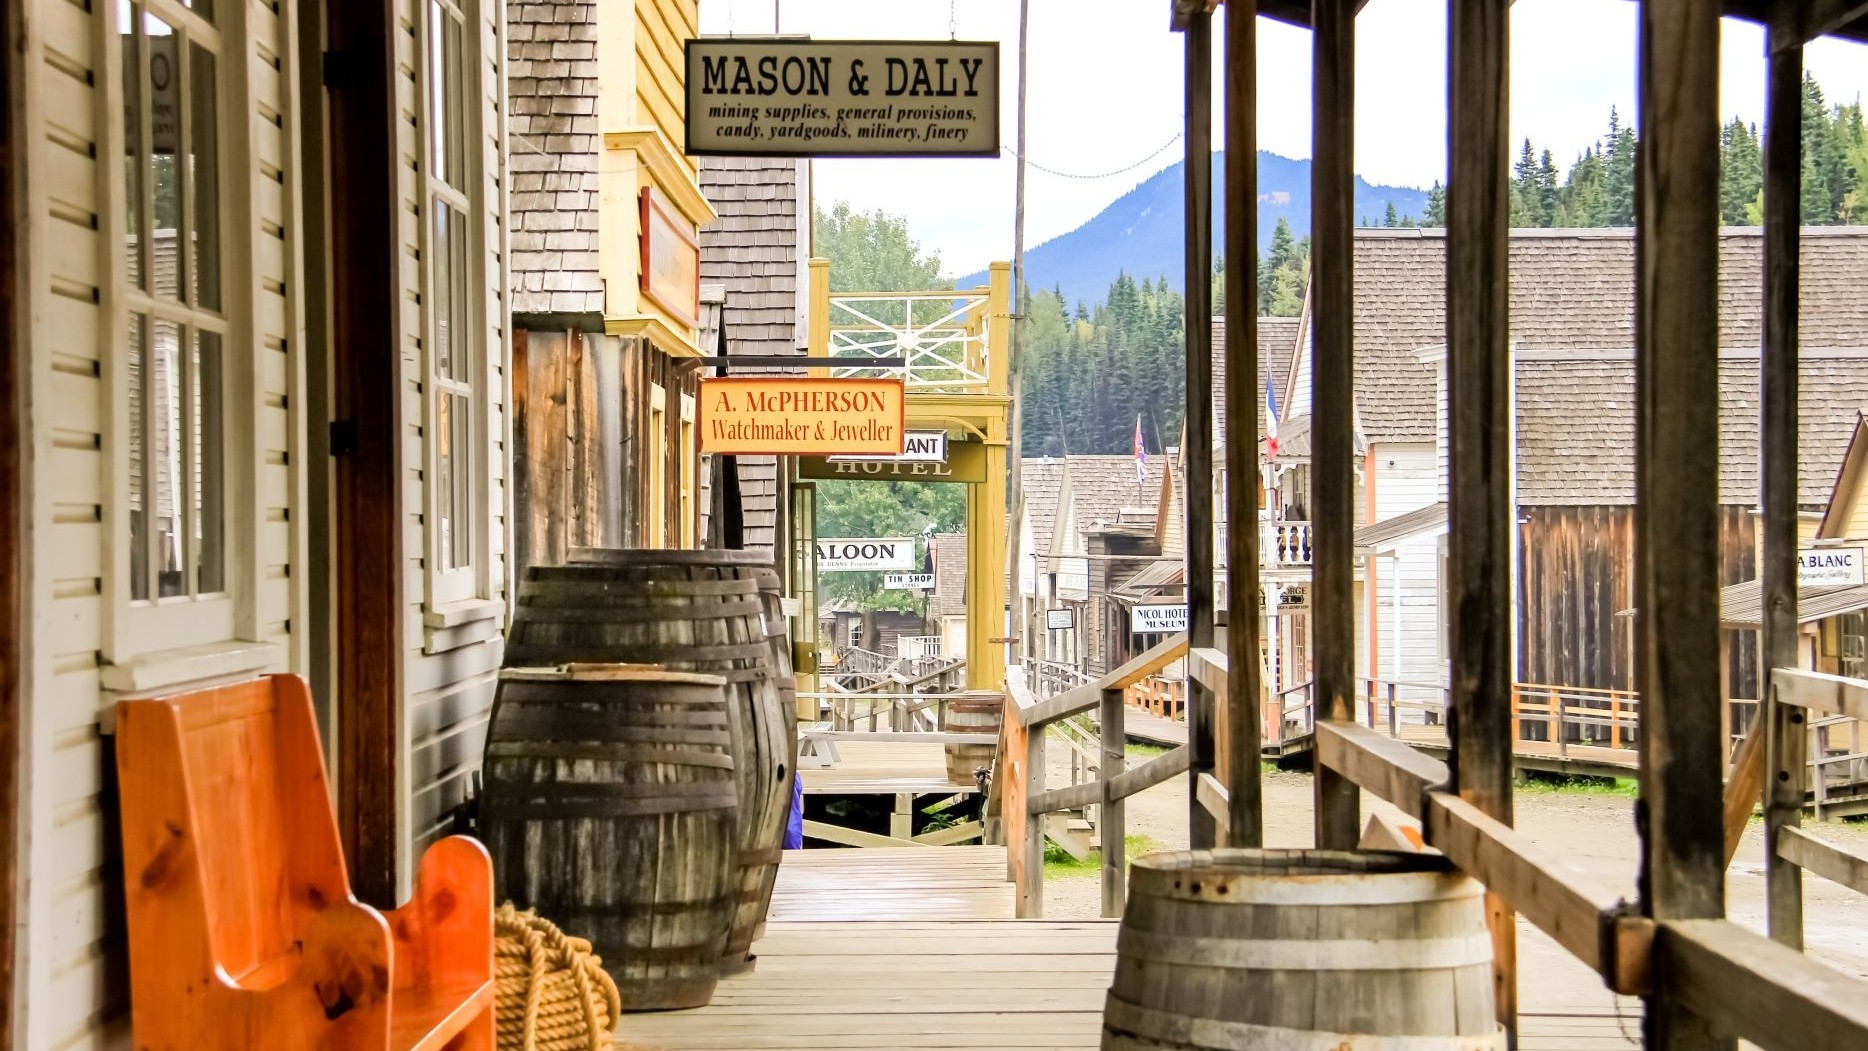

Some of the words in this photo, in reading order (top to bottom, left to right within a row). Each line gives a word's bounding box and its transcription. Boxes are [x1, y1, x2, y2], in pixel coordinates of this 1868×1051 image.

[702, 55, 832, 96] MASON
[848, 58, 869, 96] &
[885, 57, 983, 97] DALY
[708, 103, 760, 121] mining
[764, 104, 831, 122] supplies,
[836, 104, 893, 122] general
[896, 104, 977, 123] provisions,
[716, 122, 764, 140] candy,
[767, 122, 852, 141] yardgoods,
[857, 123, 921, 142] milinery,
[922, 123, 969, 142] finery
[715, 391, 737, 412] A.
[745, 391, 886, 413] McPHERSON
[711, 418, 810, 441] Watchmaker
[814, 420, 826, 441] &
[830, 418, 893, 442] Jeweller
[904, 438, 938, 454] ANT
[817, 544, 895, 560] ALOON
[888, 575, 903, 583] TIN
[908, 574, 932, 583] SHOP
[1137, 609, 1163, 619] NICOL
[1165, 608, 1188, 619] HOTE
[1145, 620, 1185, 628] MUSEUM
